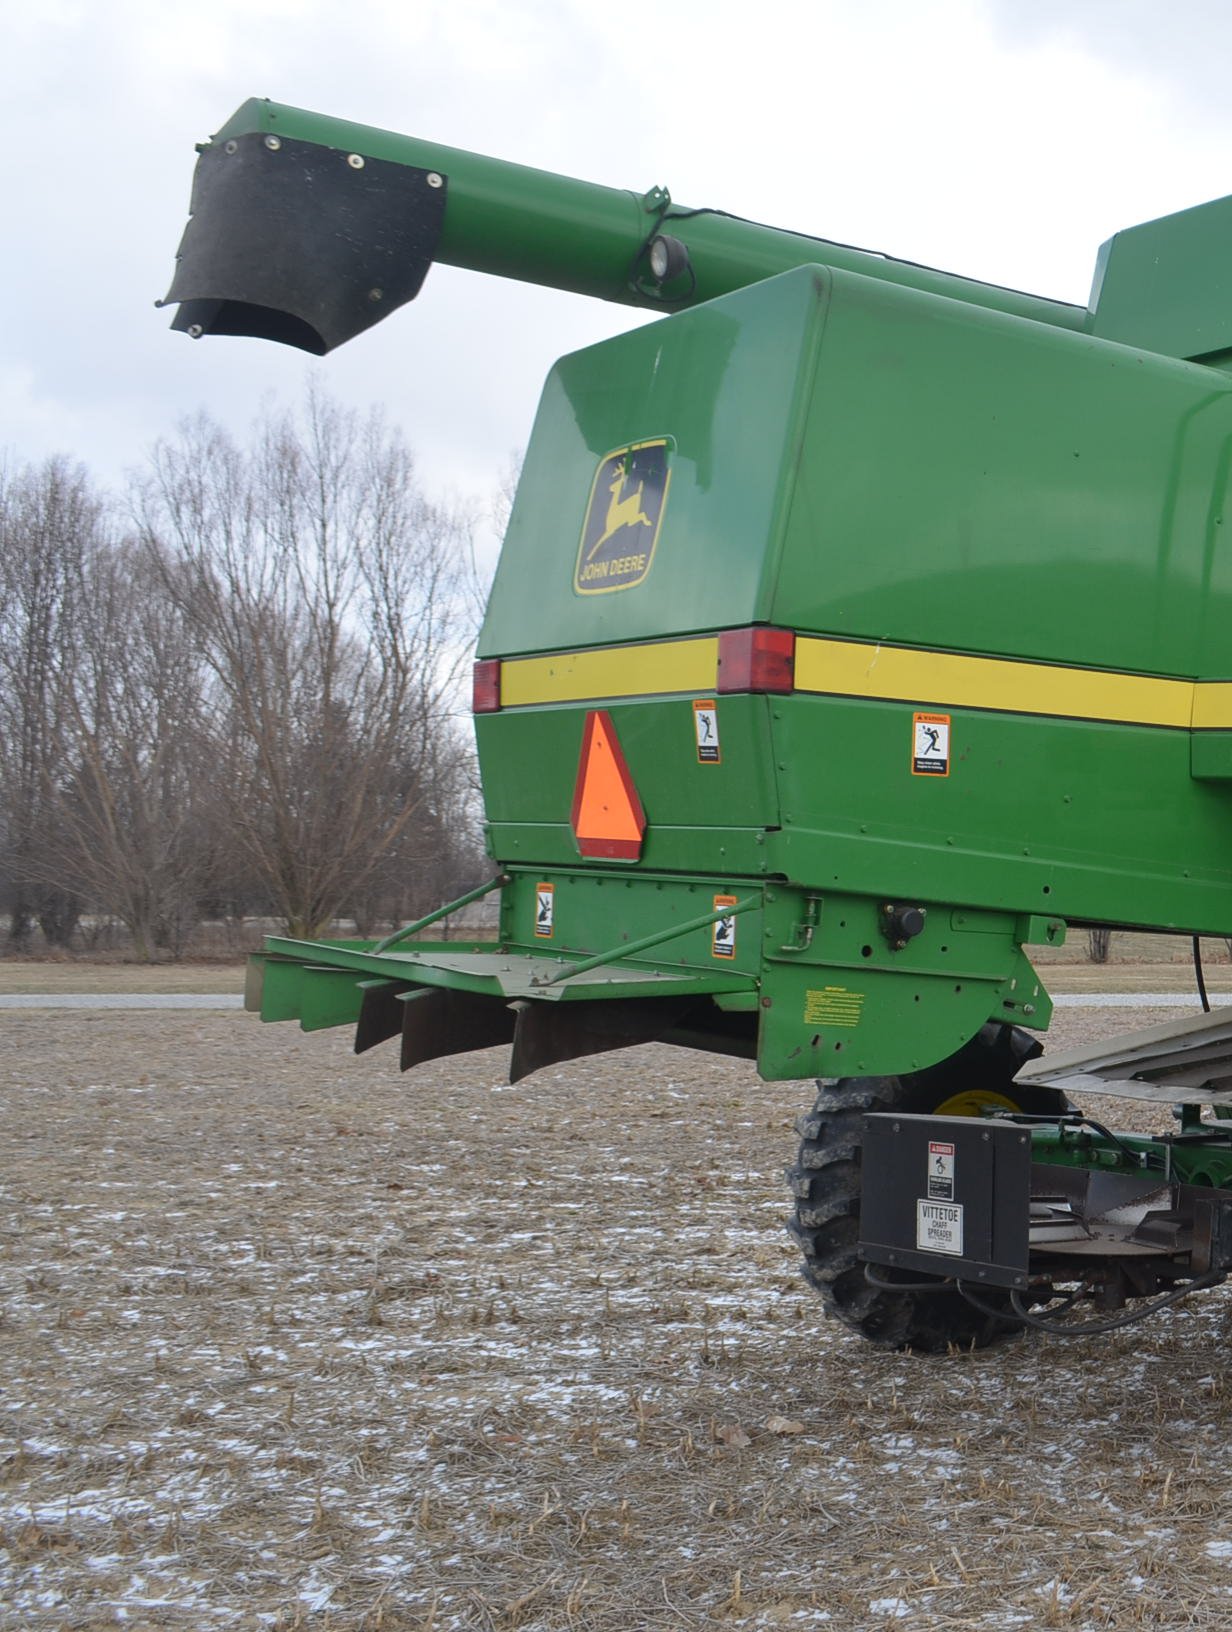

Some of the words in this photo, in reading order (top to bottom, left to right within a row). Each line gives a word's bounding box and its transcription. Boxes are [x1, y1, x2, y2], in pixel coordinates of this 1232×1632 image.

[580, 561, 609, 581] JOHN
[610, 554, 646, 576] DEERE
[922, 1205, 958, 1222] VITTETOE
